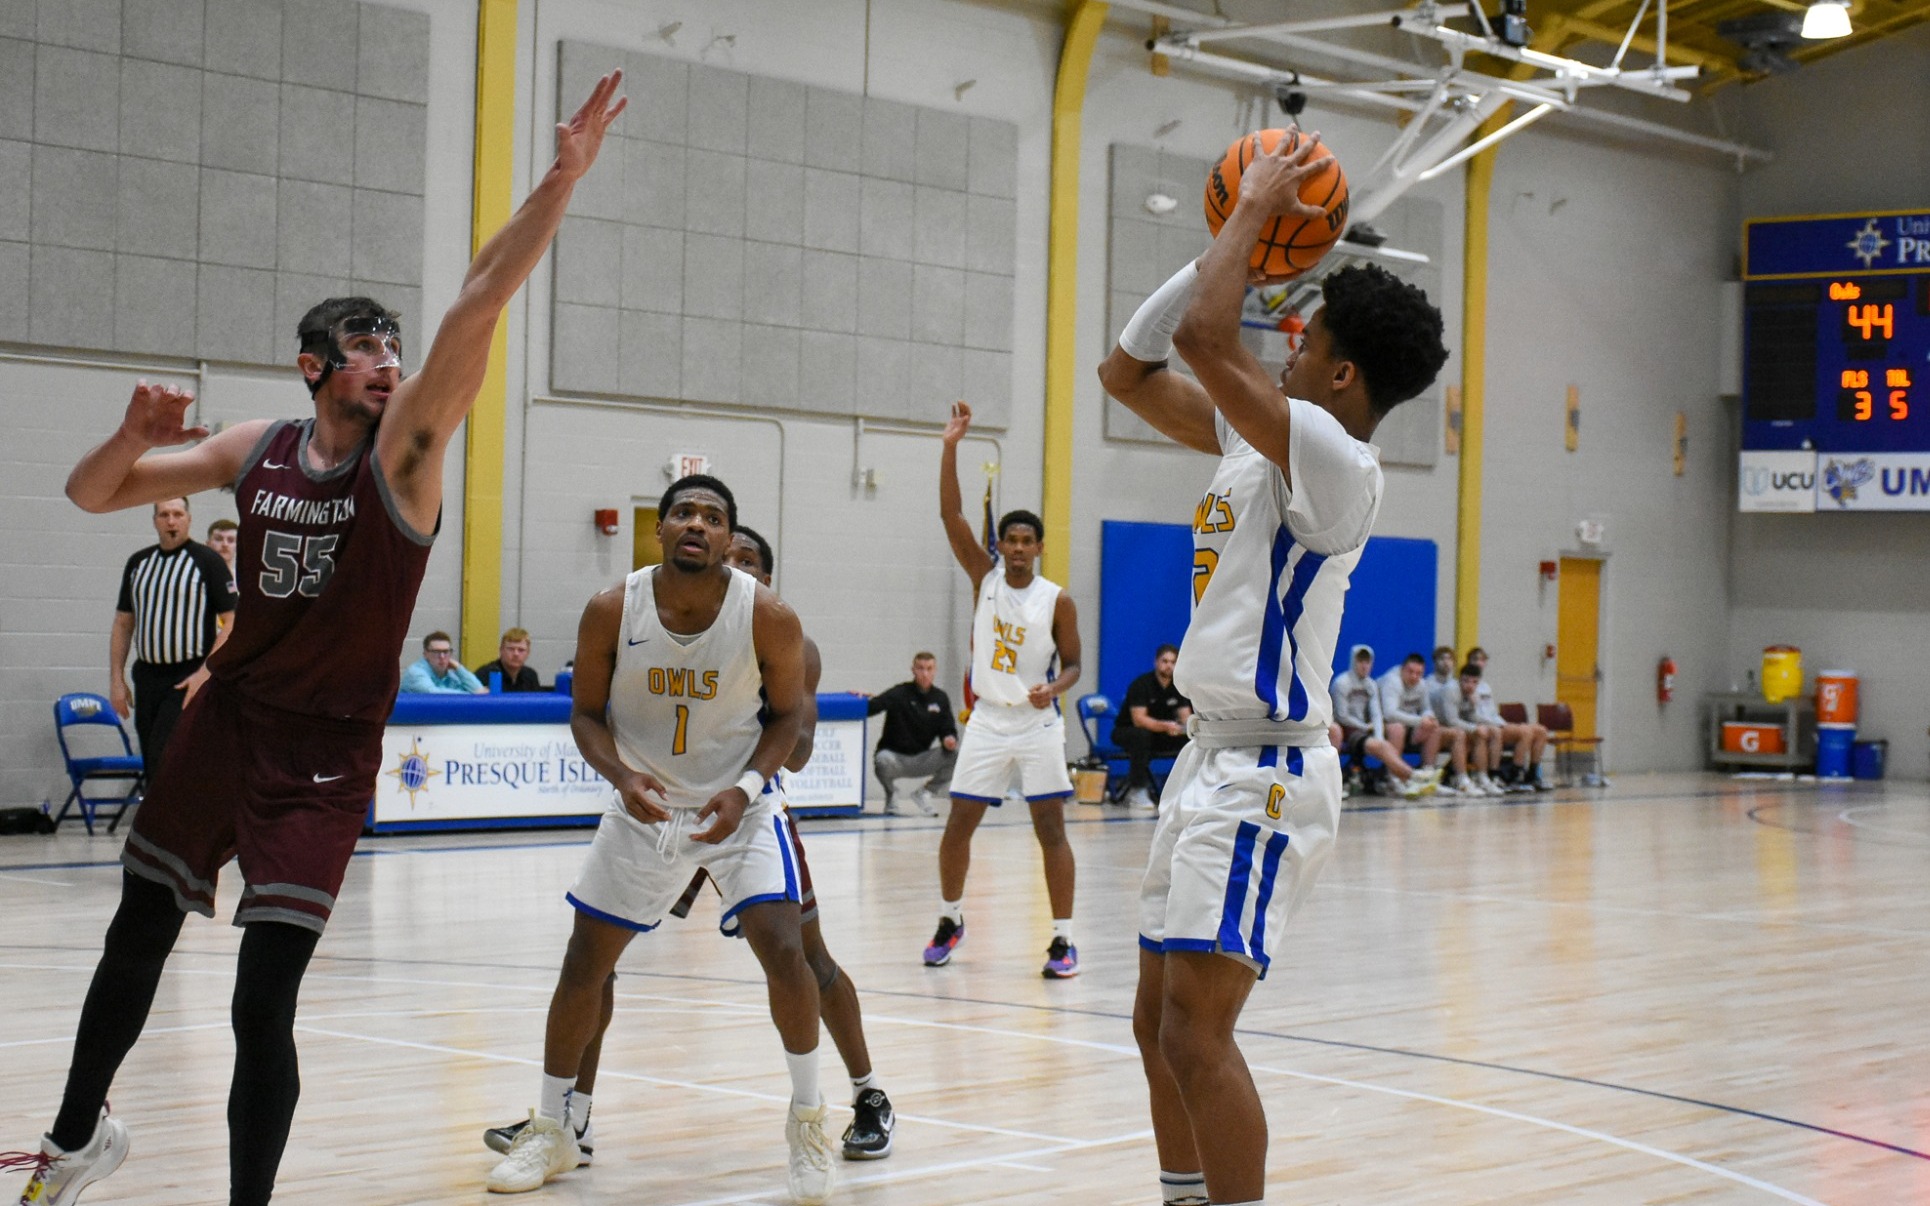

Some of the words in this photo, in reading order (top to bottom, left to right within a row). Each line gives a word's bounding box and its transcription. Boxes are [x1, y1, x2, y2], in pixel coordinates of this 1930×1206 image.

[1897, 216, 1930, 236] Uni
[1898, 236, 1930, 263] PR
[1848, 304, 1893, 339] 44
[1855, 391, 1872, 420] 3
[1889, 390, 1908, 420] 5
[1772, 472, 1815, 490] UCU
[1881, 467, 1930, 496] UM
[258, 529, 339, 598] 55
[648, 667, 719, 700] OWLS
[672, 704, 689, 756] 1
[1740, 730, 1760, 752] G
[473, 741, 535, 763] University
[539, 740, 552, 763] of
[445, 759, 550, 790] PRESQUE
